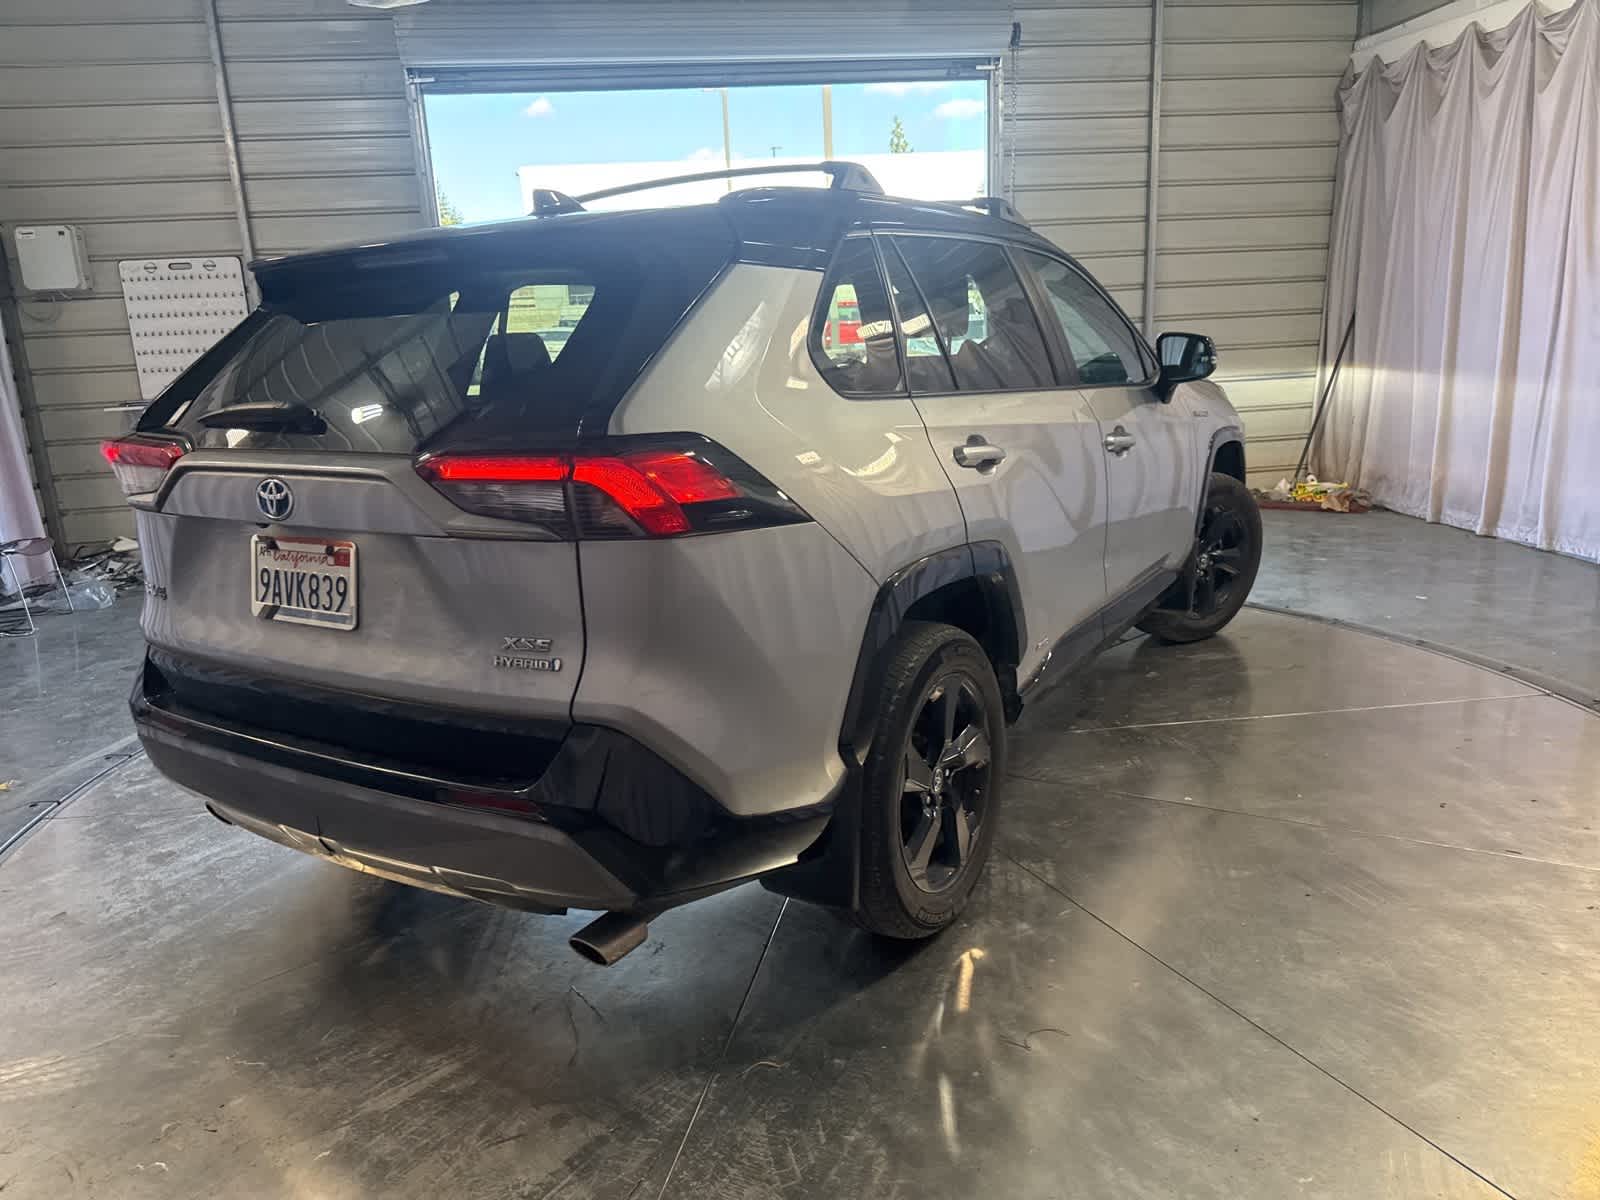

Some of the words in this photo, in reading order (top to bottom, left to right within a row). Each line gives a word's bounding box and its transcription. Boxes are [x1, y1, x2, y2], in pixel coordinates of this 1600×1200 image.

[273, 551, 328, 568] California
[260, 567, 348, 613] 9AVK839
[503, 637, 552, 652] XSE
[494, 656, 551, 671] HYBRID
